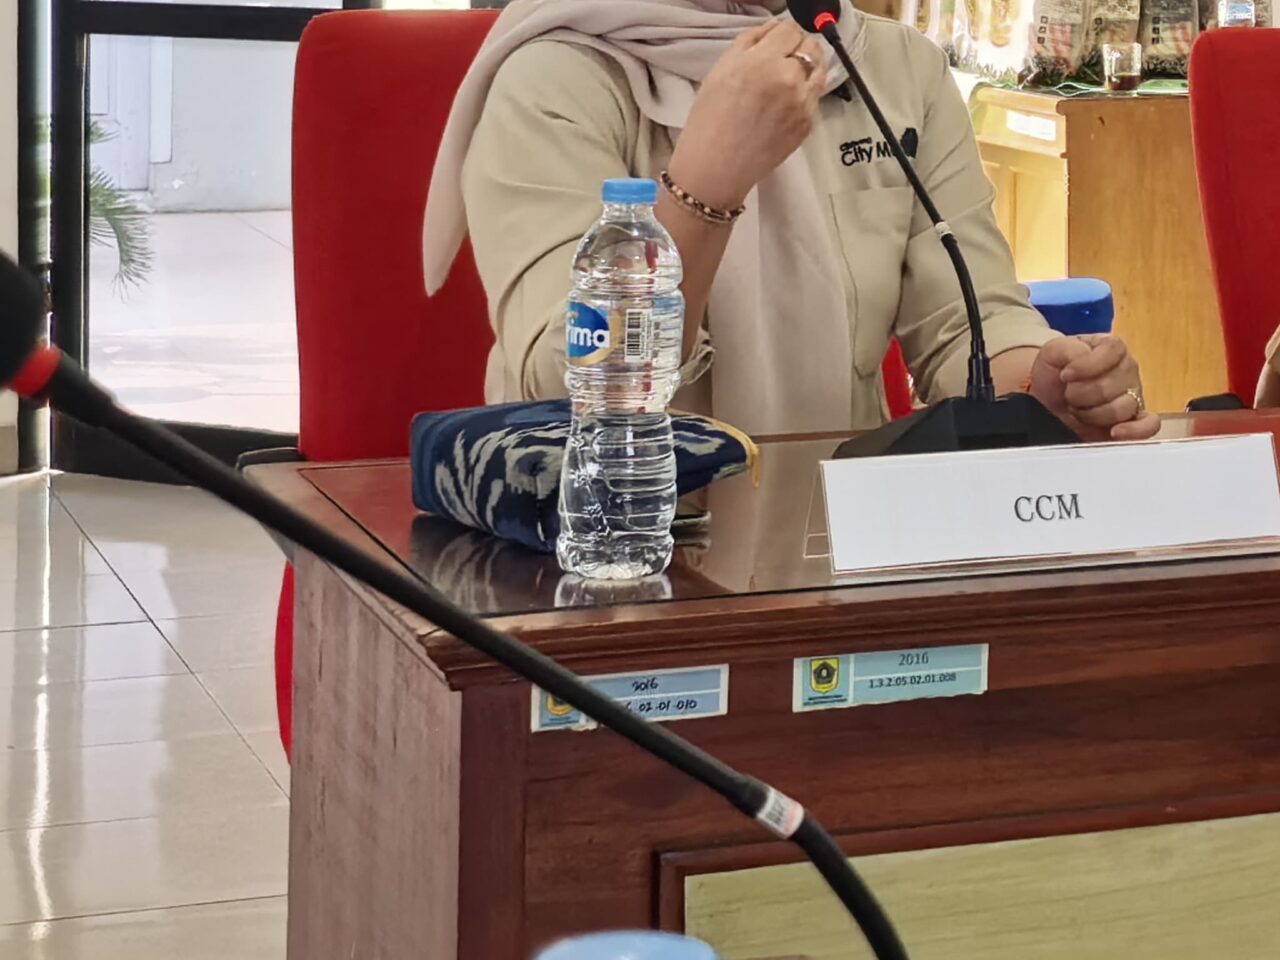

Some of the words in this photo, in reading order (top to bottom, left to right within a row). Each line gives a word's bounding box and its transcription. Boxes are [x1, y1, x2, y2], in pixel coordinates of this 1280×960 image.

[841, 145, 873, 167] City
[876, 141, 894, 158] M
[1013, 493, 1084, 523] CCM
[898, 652, 929, 666] 2016
[632, 677, 659, 692] 2016
